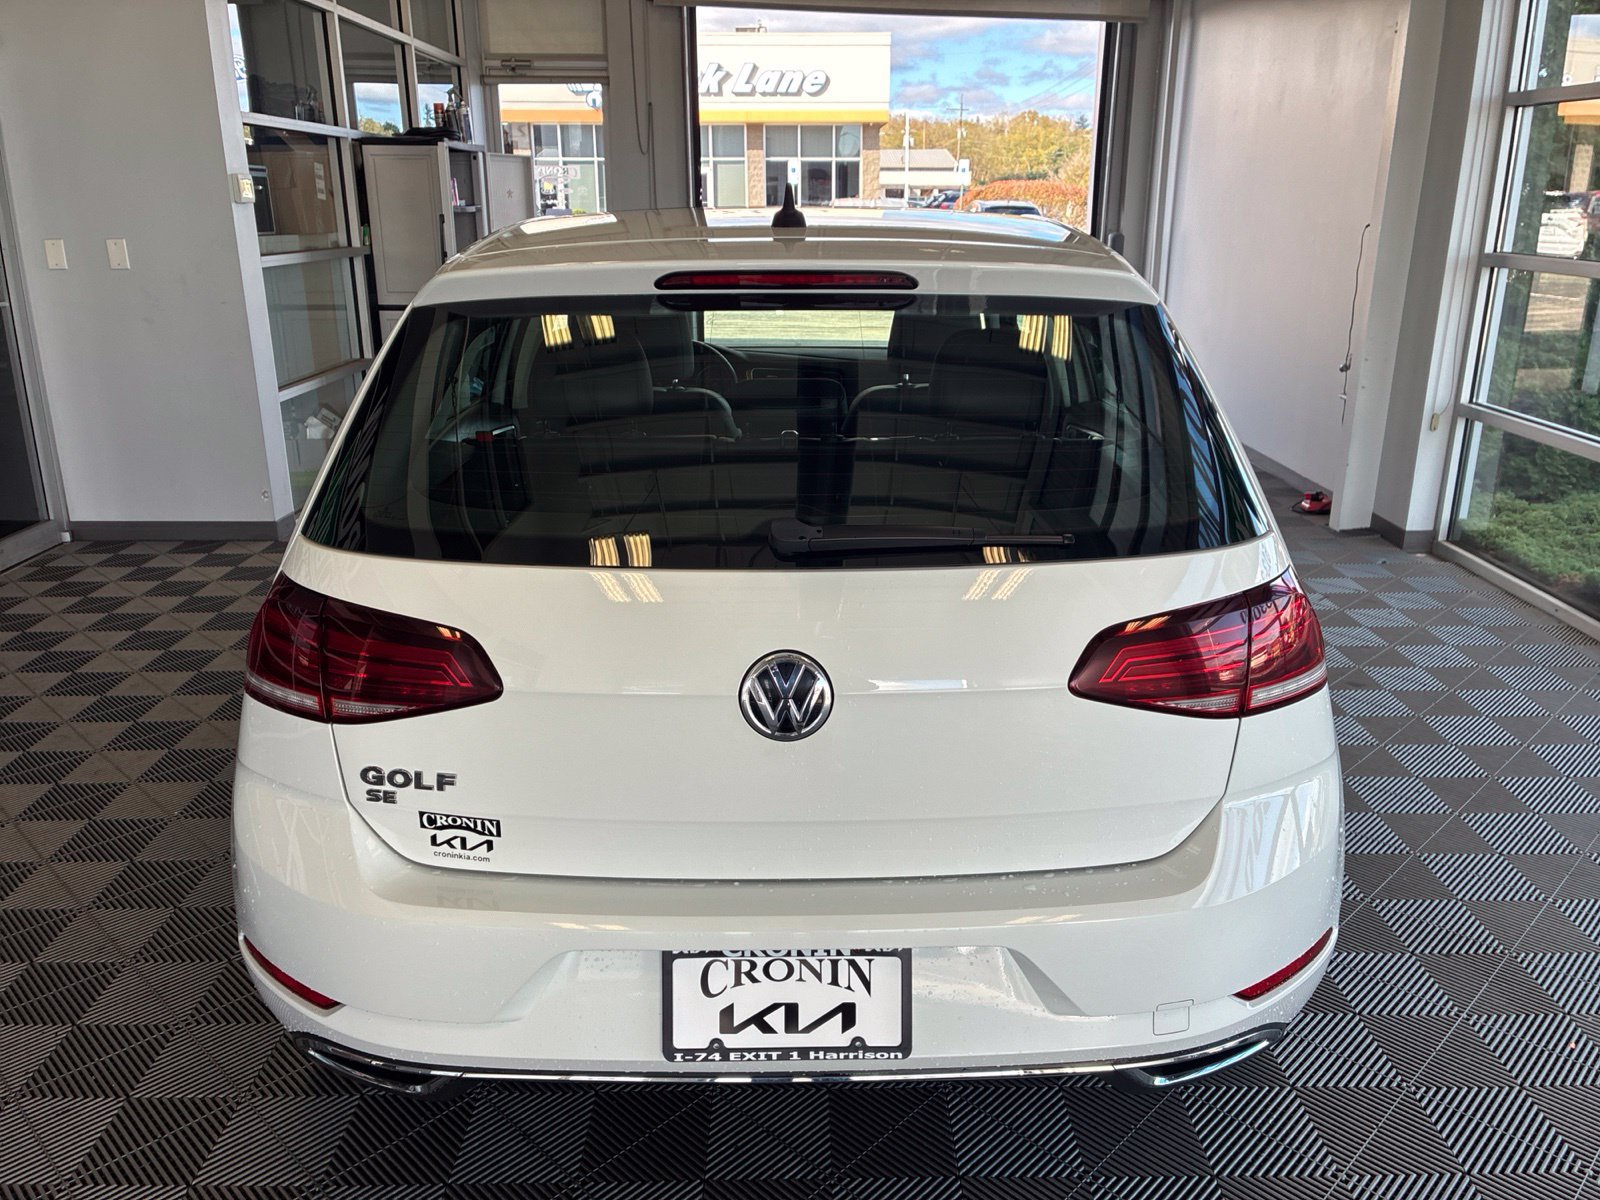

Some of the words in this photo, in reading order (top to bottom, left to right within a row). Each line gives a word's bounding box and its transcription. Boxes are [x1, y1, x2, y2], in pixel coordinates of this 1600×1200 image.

[698, 62, 732, 97] k
[731, 62, 831, 97] Lane
[359, 765, 457, 791] GOLF
[366, 788, 397, 804] SE
[421, 812, 498, 836] CRONIN
[433, 850, 491, 863] croninkia.com
[700, 958, 875, 998] CRONIN
[673, 1052, 722, 1062] I-74
[729, 1051, 782, 1061] EXIT
[788, 1051, 801, 1060] 1
[809, 1050, 903, 1060] Harrison
